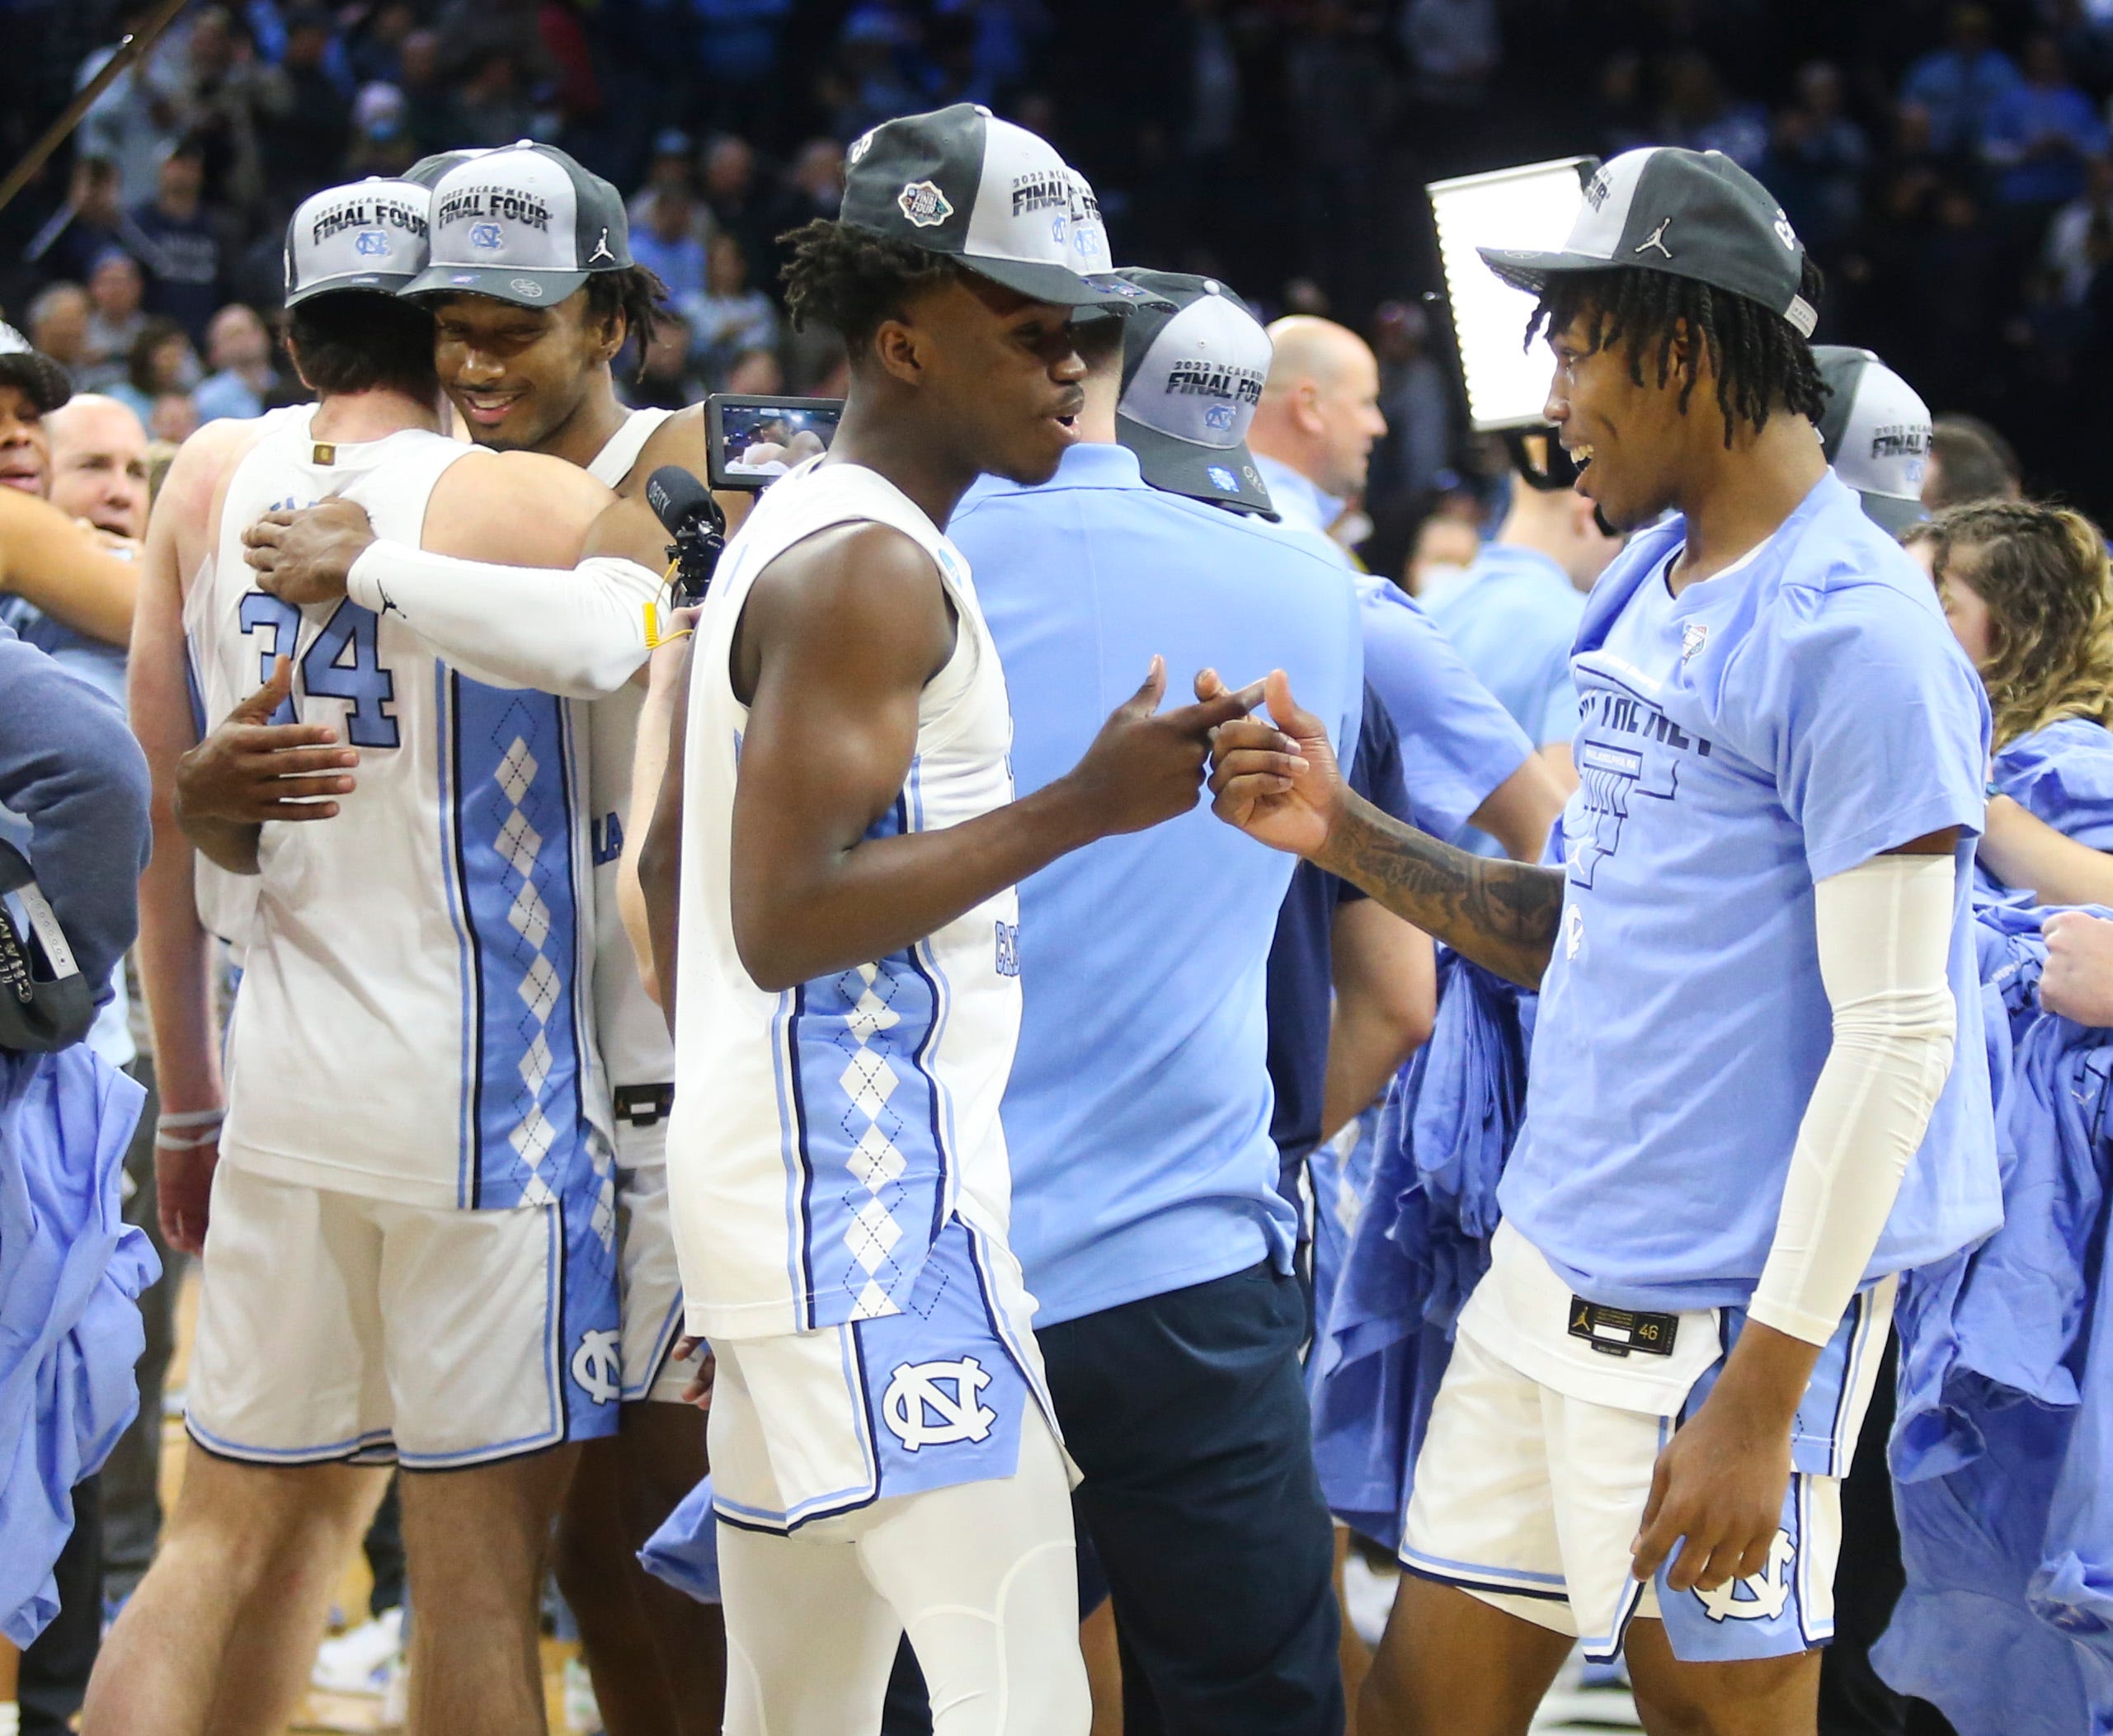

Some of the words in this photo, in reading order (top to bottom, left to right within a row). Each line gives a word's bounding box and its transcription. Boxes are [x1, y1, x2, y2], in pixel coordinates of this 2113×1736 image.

[1013, 172, 1044, 188] 2022
[1012, 181, 1066, 217] FINAL
[313, 205, 371, 246] FINAL
[439, 195, 485, 229] FINAL
[490, 195, 549, 233] FOUR
[1174, 361, 1212, 371] 2022
[1165, 372, 1233, 399] FINAL
[1871, 434, 1922, 459] FINAL
[648, 481, 671, 515] DEITY
[1638, 1323, 1659, 1341] 46
